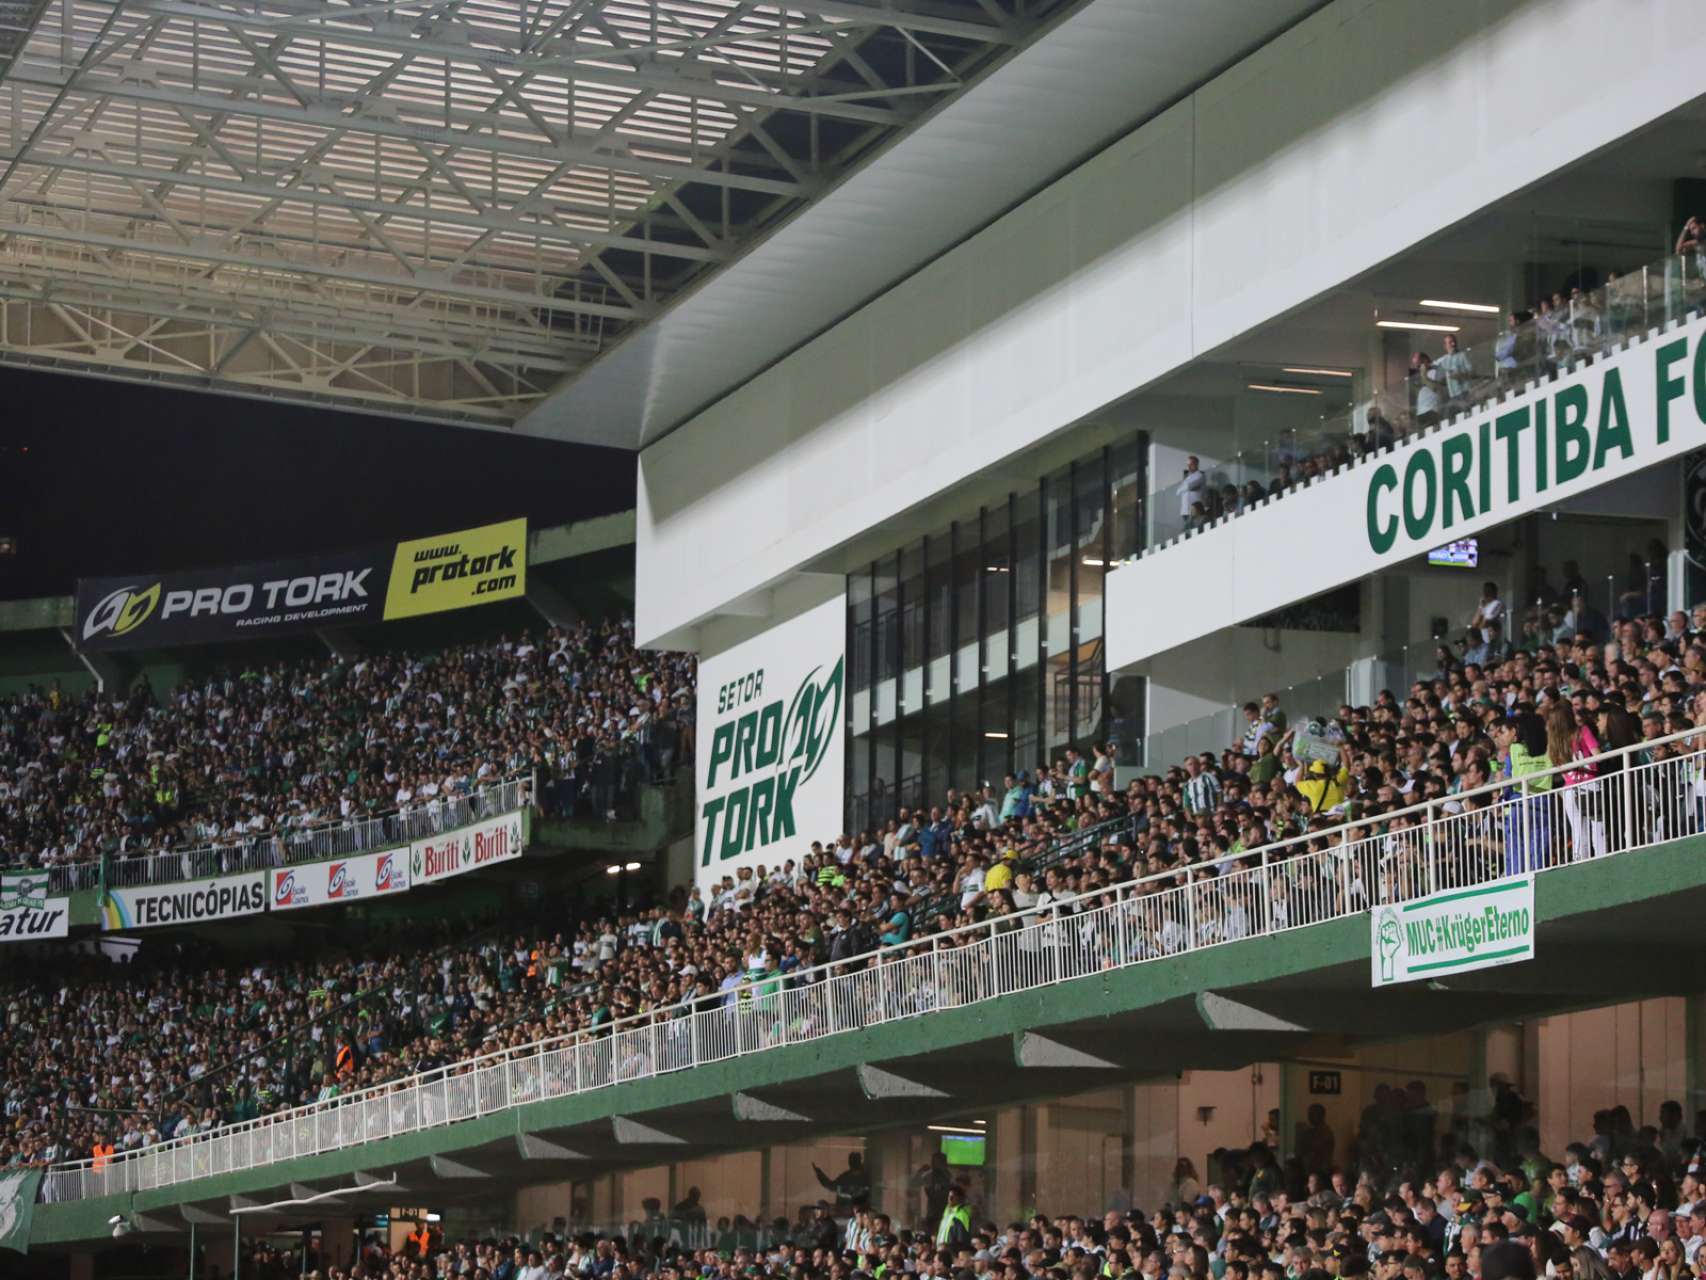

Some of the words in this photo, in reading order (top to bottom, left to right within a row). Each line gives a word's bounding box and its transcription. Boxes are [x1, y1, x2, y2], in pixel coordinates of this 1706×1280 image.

[1367, 367, 1633, 554] CORITIBA
[410, 545, 518, 594] protork
[413, 542, 462, 563] www.
[161, 584, 254, 619] PRO
[263, 567, 373, 608] TORK
[471, 574, 517, 596] .com
[236, 613, 282, 627] RACING
[285, 603, 368, 623] DEVELOPMENT
[717, 668, 764, 715] SETOR
[706, 699, 784, 790] PRO
[702, 764, 803, 867] TORK
[135, 881, 265, 925] TECNICÓPIAS
